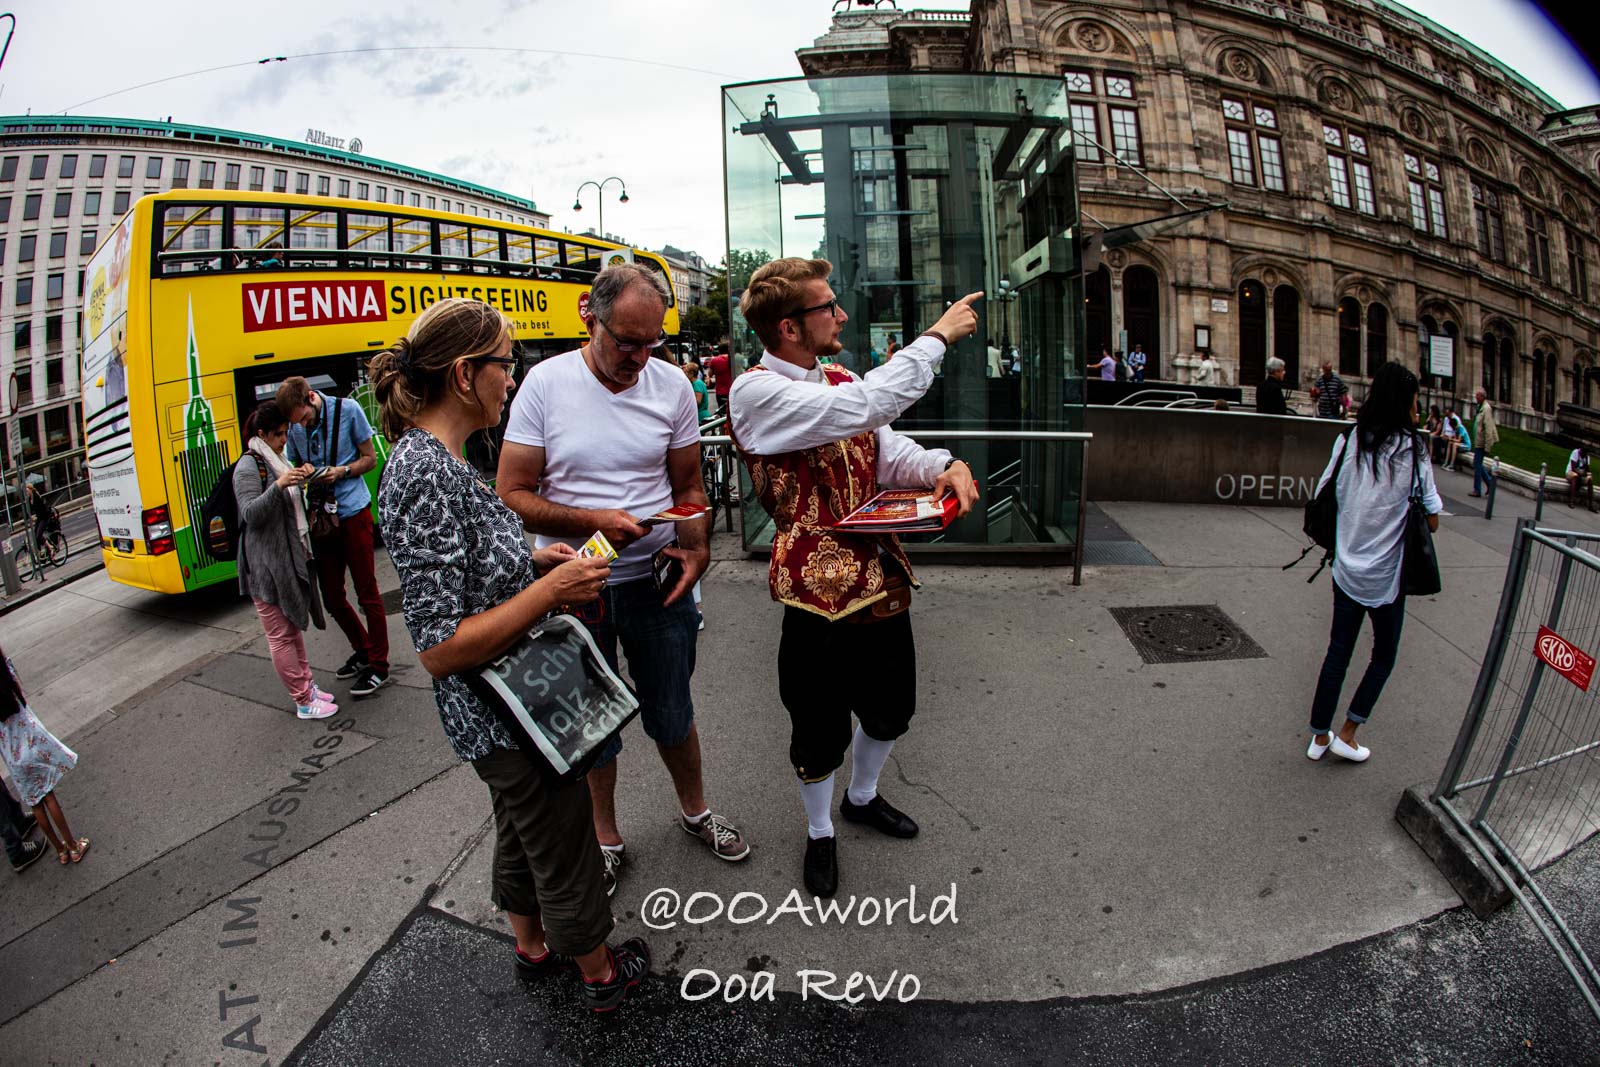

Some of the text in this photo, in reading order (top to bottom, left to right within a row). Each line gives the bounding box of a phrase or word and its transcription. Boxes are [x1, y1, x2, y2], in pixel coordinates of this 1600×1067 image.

[305, 128, 346, 149] Allianz
[248, 286, 381, 324] VIENNA
[513, 320, 550, 329] he best
[1541, 637, 1573, 668] EKRO
[219, 717, 356, 1067] AT IM AUSMASS
